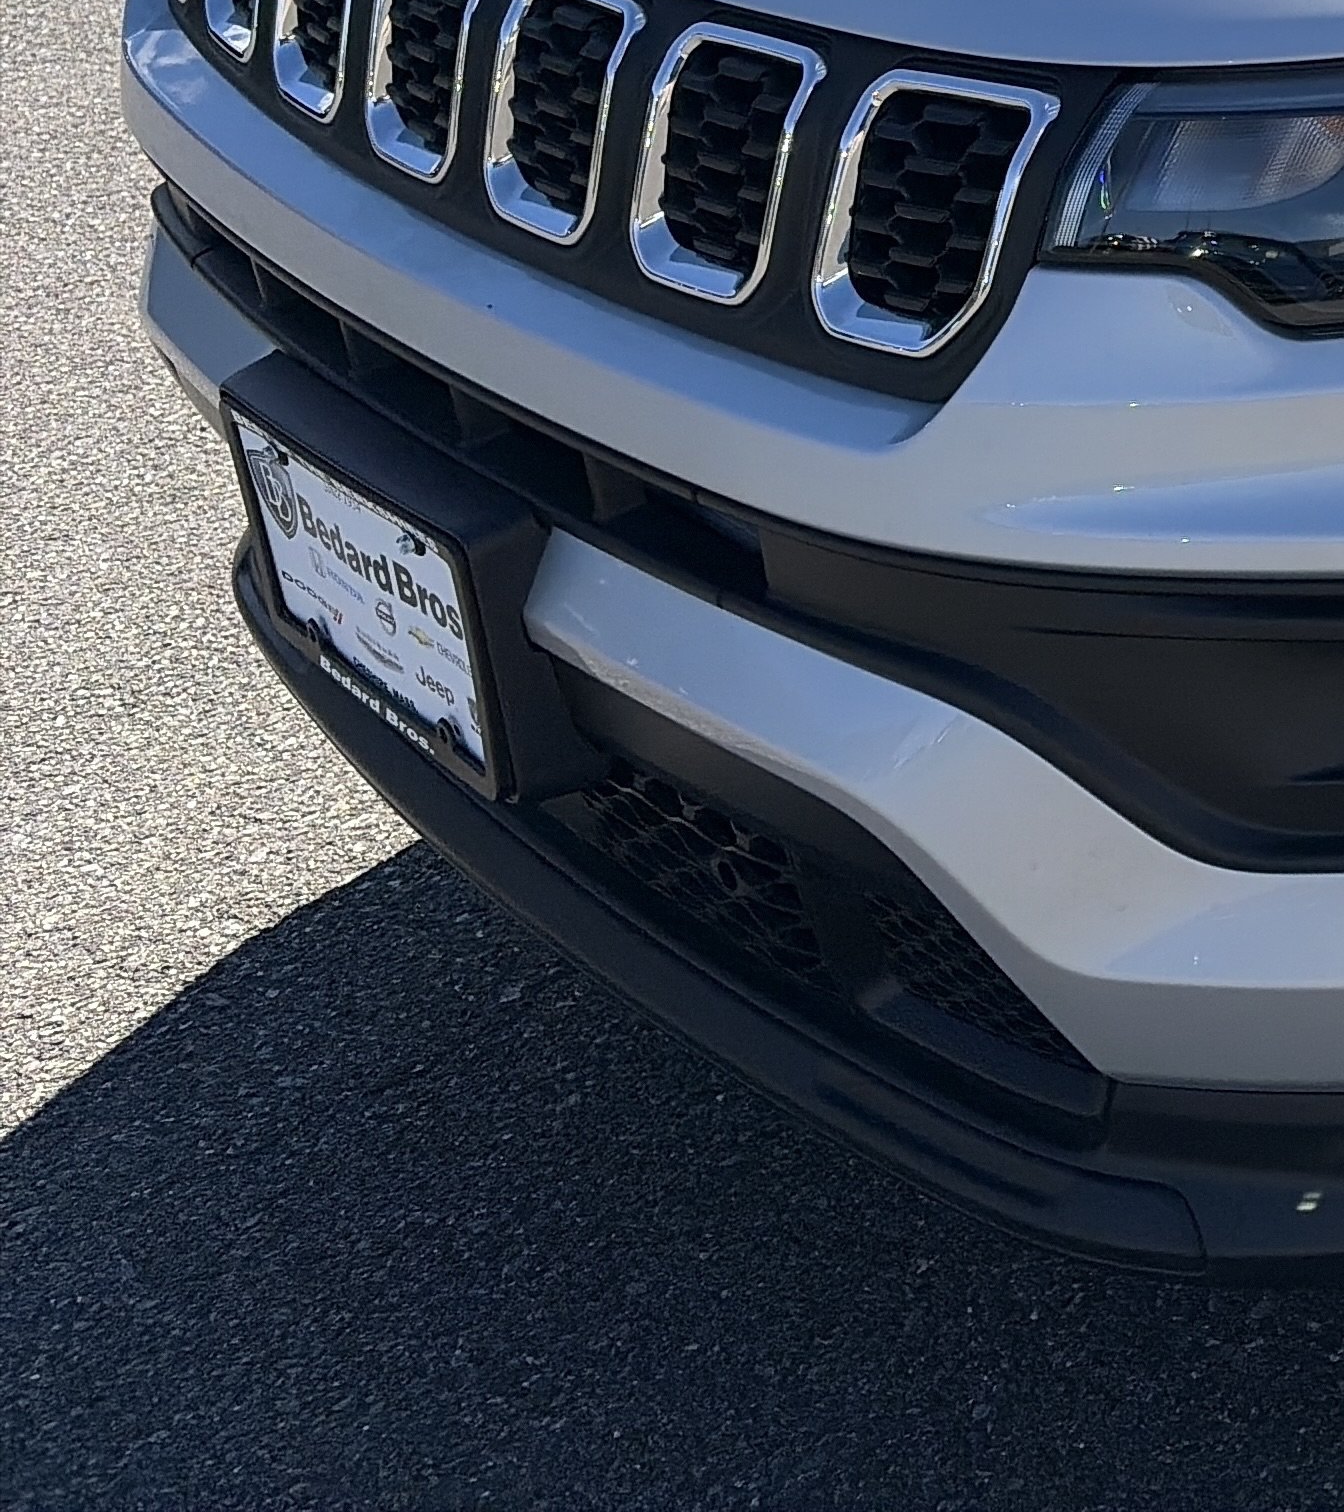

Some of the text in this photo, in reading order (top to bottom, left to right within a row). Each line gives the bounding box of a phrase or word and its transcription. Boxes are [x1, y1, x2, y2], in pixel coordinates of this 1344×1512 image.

[296, 492, 394, 595] Bedard
[320, 654, 435, 756] Bedard Bros.
[415, 665, 454, 706] Jeep
